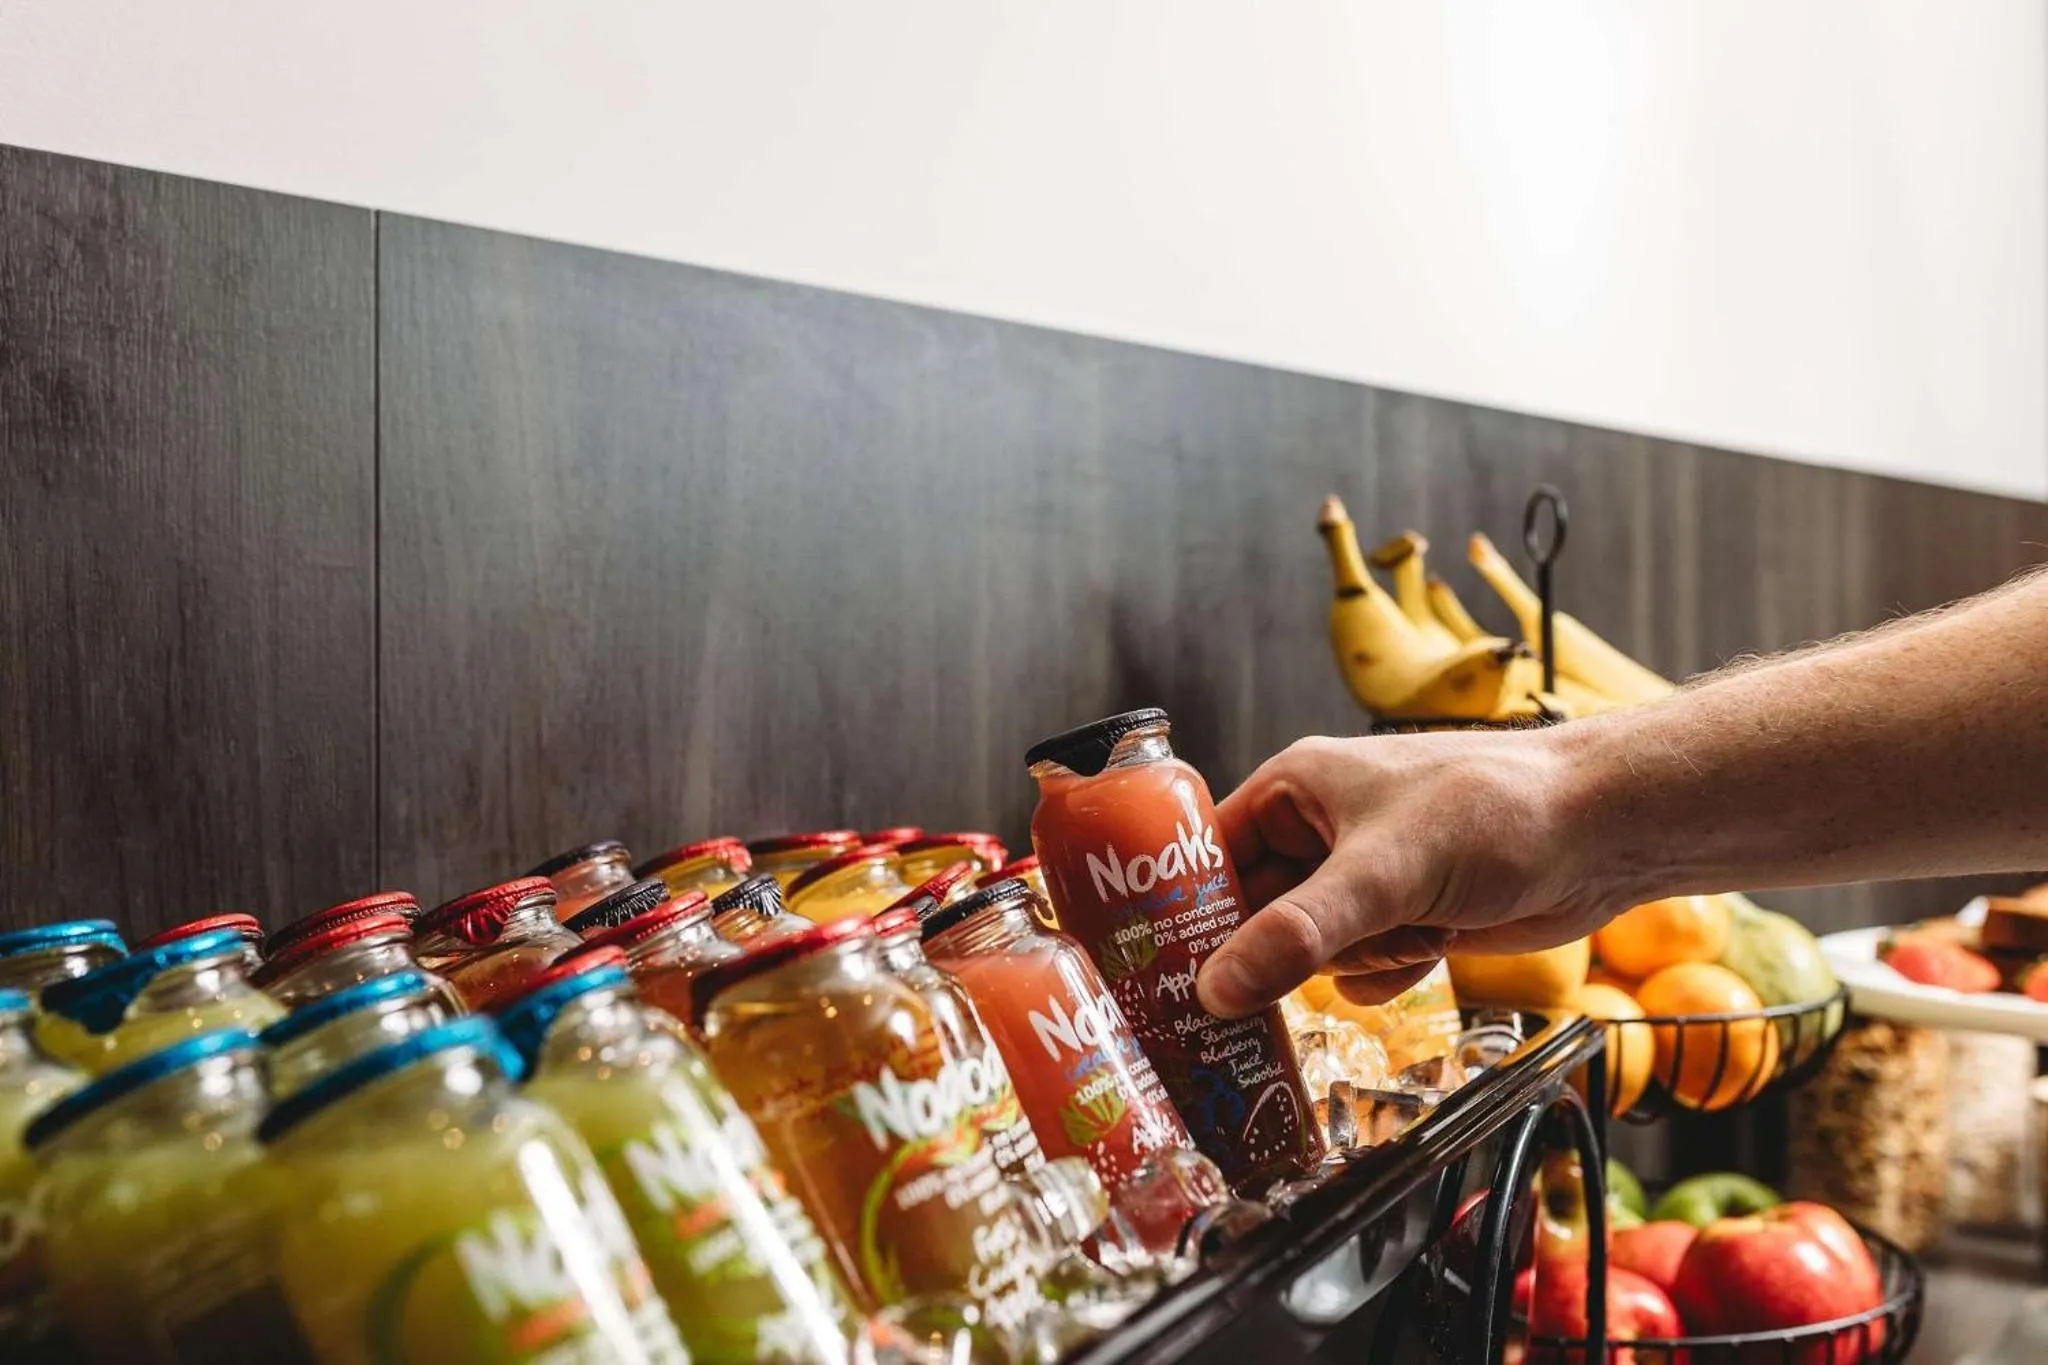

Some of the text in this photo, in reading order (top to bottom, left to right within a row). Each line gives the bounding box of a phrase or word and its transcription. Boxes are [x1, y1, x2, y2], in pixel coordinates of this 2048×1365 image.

[1114, 920, 1152, 945] 100%
[1153, 917, 1173, 932] no
[1174, 896, 1236, 924] concentrate
[1154, 929, 1177, 947] 0%
[1179, 915, 1217, 940] added
[1188, 936, 1209, 954] 0%
[1156, 957, 1197, 1002] Appl
[1174, 1012, 1220, 1034] Blac
[1200, 1038, 1262, 1064] Blueberry
